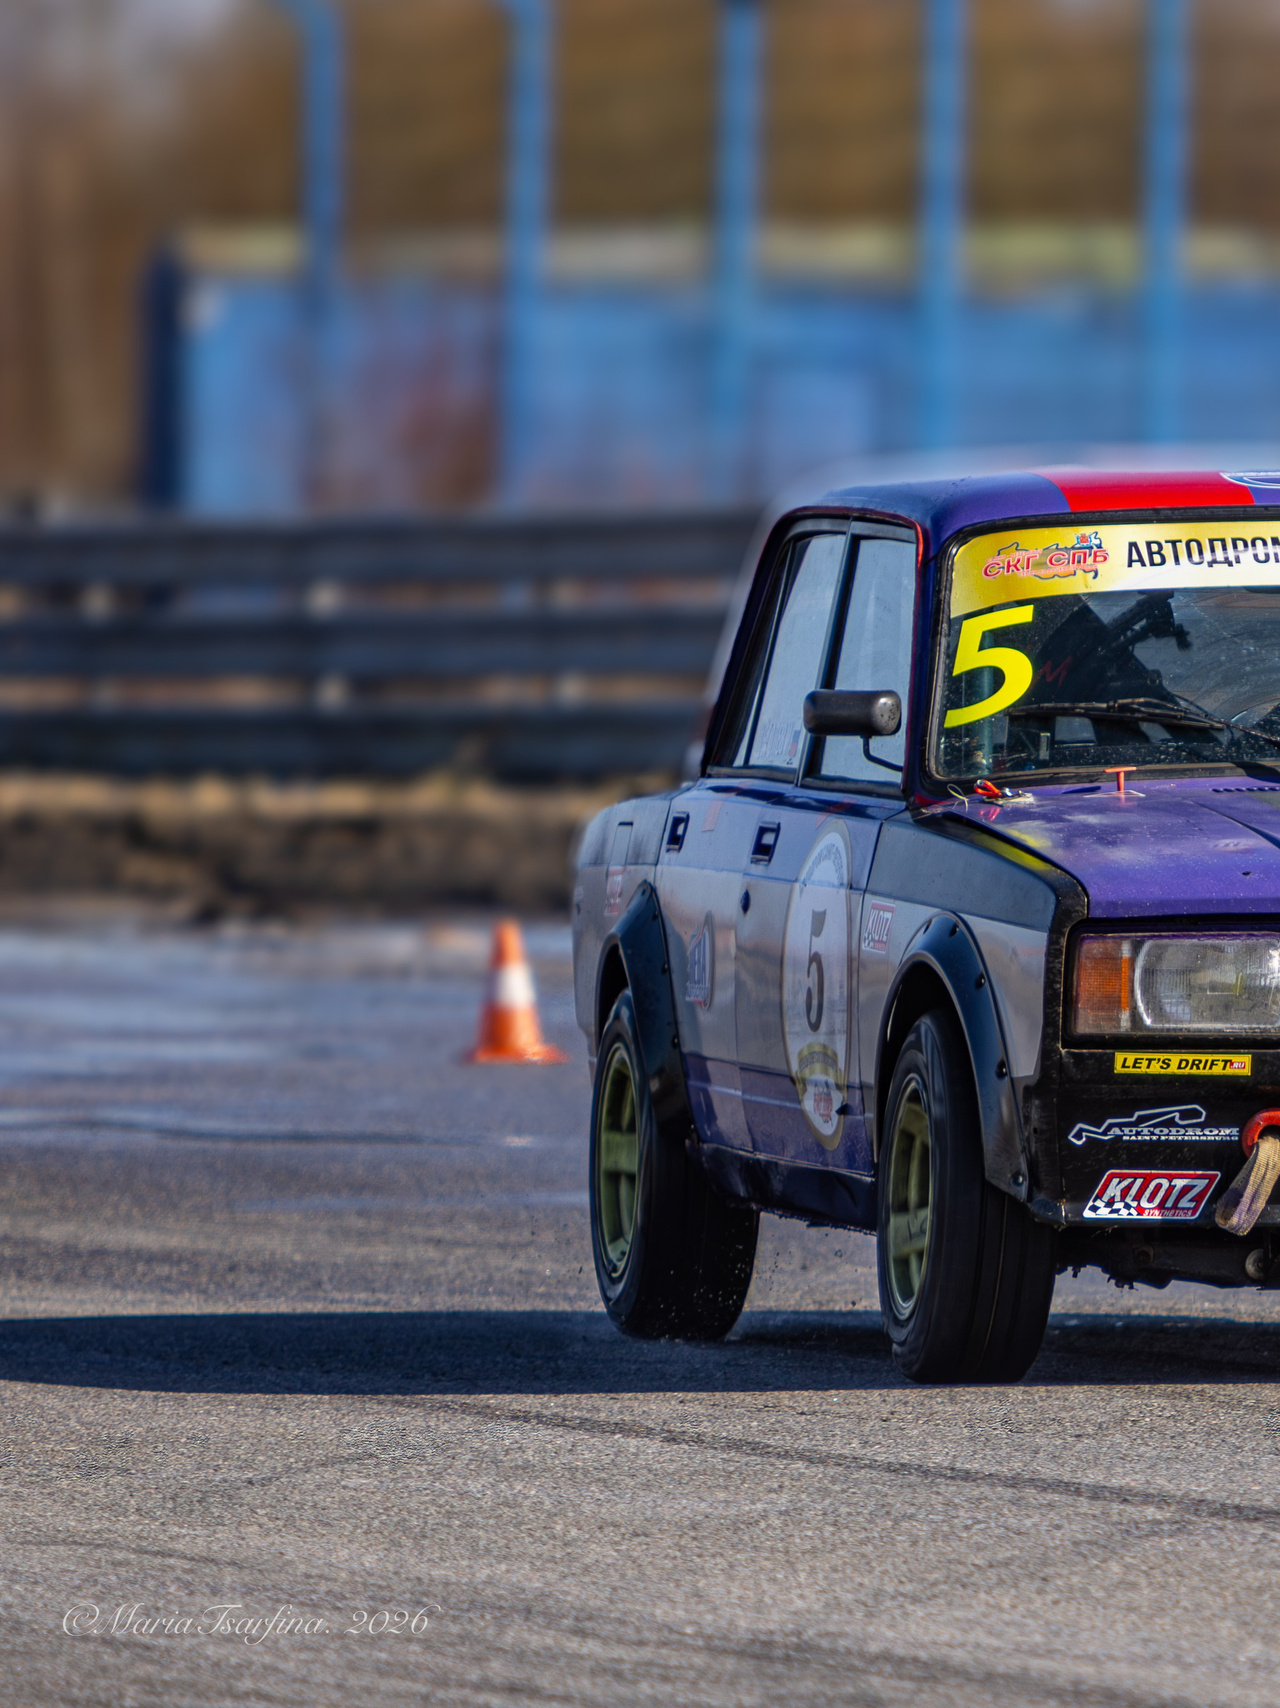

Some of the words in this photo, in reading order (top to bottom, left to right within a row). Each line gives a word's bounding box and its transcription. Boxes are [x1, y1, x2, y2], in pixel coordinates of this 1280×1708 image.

[982, 554, 1040, 579] СКГ
[1047, 548, 1109, 568] СПБ
[944, 604, 1034, 728] 5
[866, 908, 893, 942] KLOTZ
[804, 908, 828, 1033] 5
[1120, 1057, 1172, 1070] LET'S
[1107, 1127, 1240, 1136] AUTODROM
[1100, 1177, 1209, 1209] KLOTZ
[1142, 1209, 1193, 1217] SYNTHETICS
